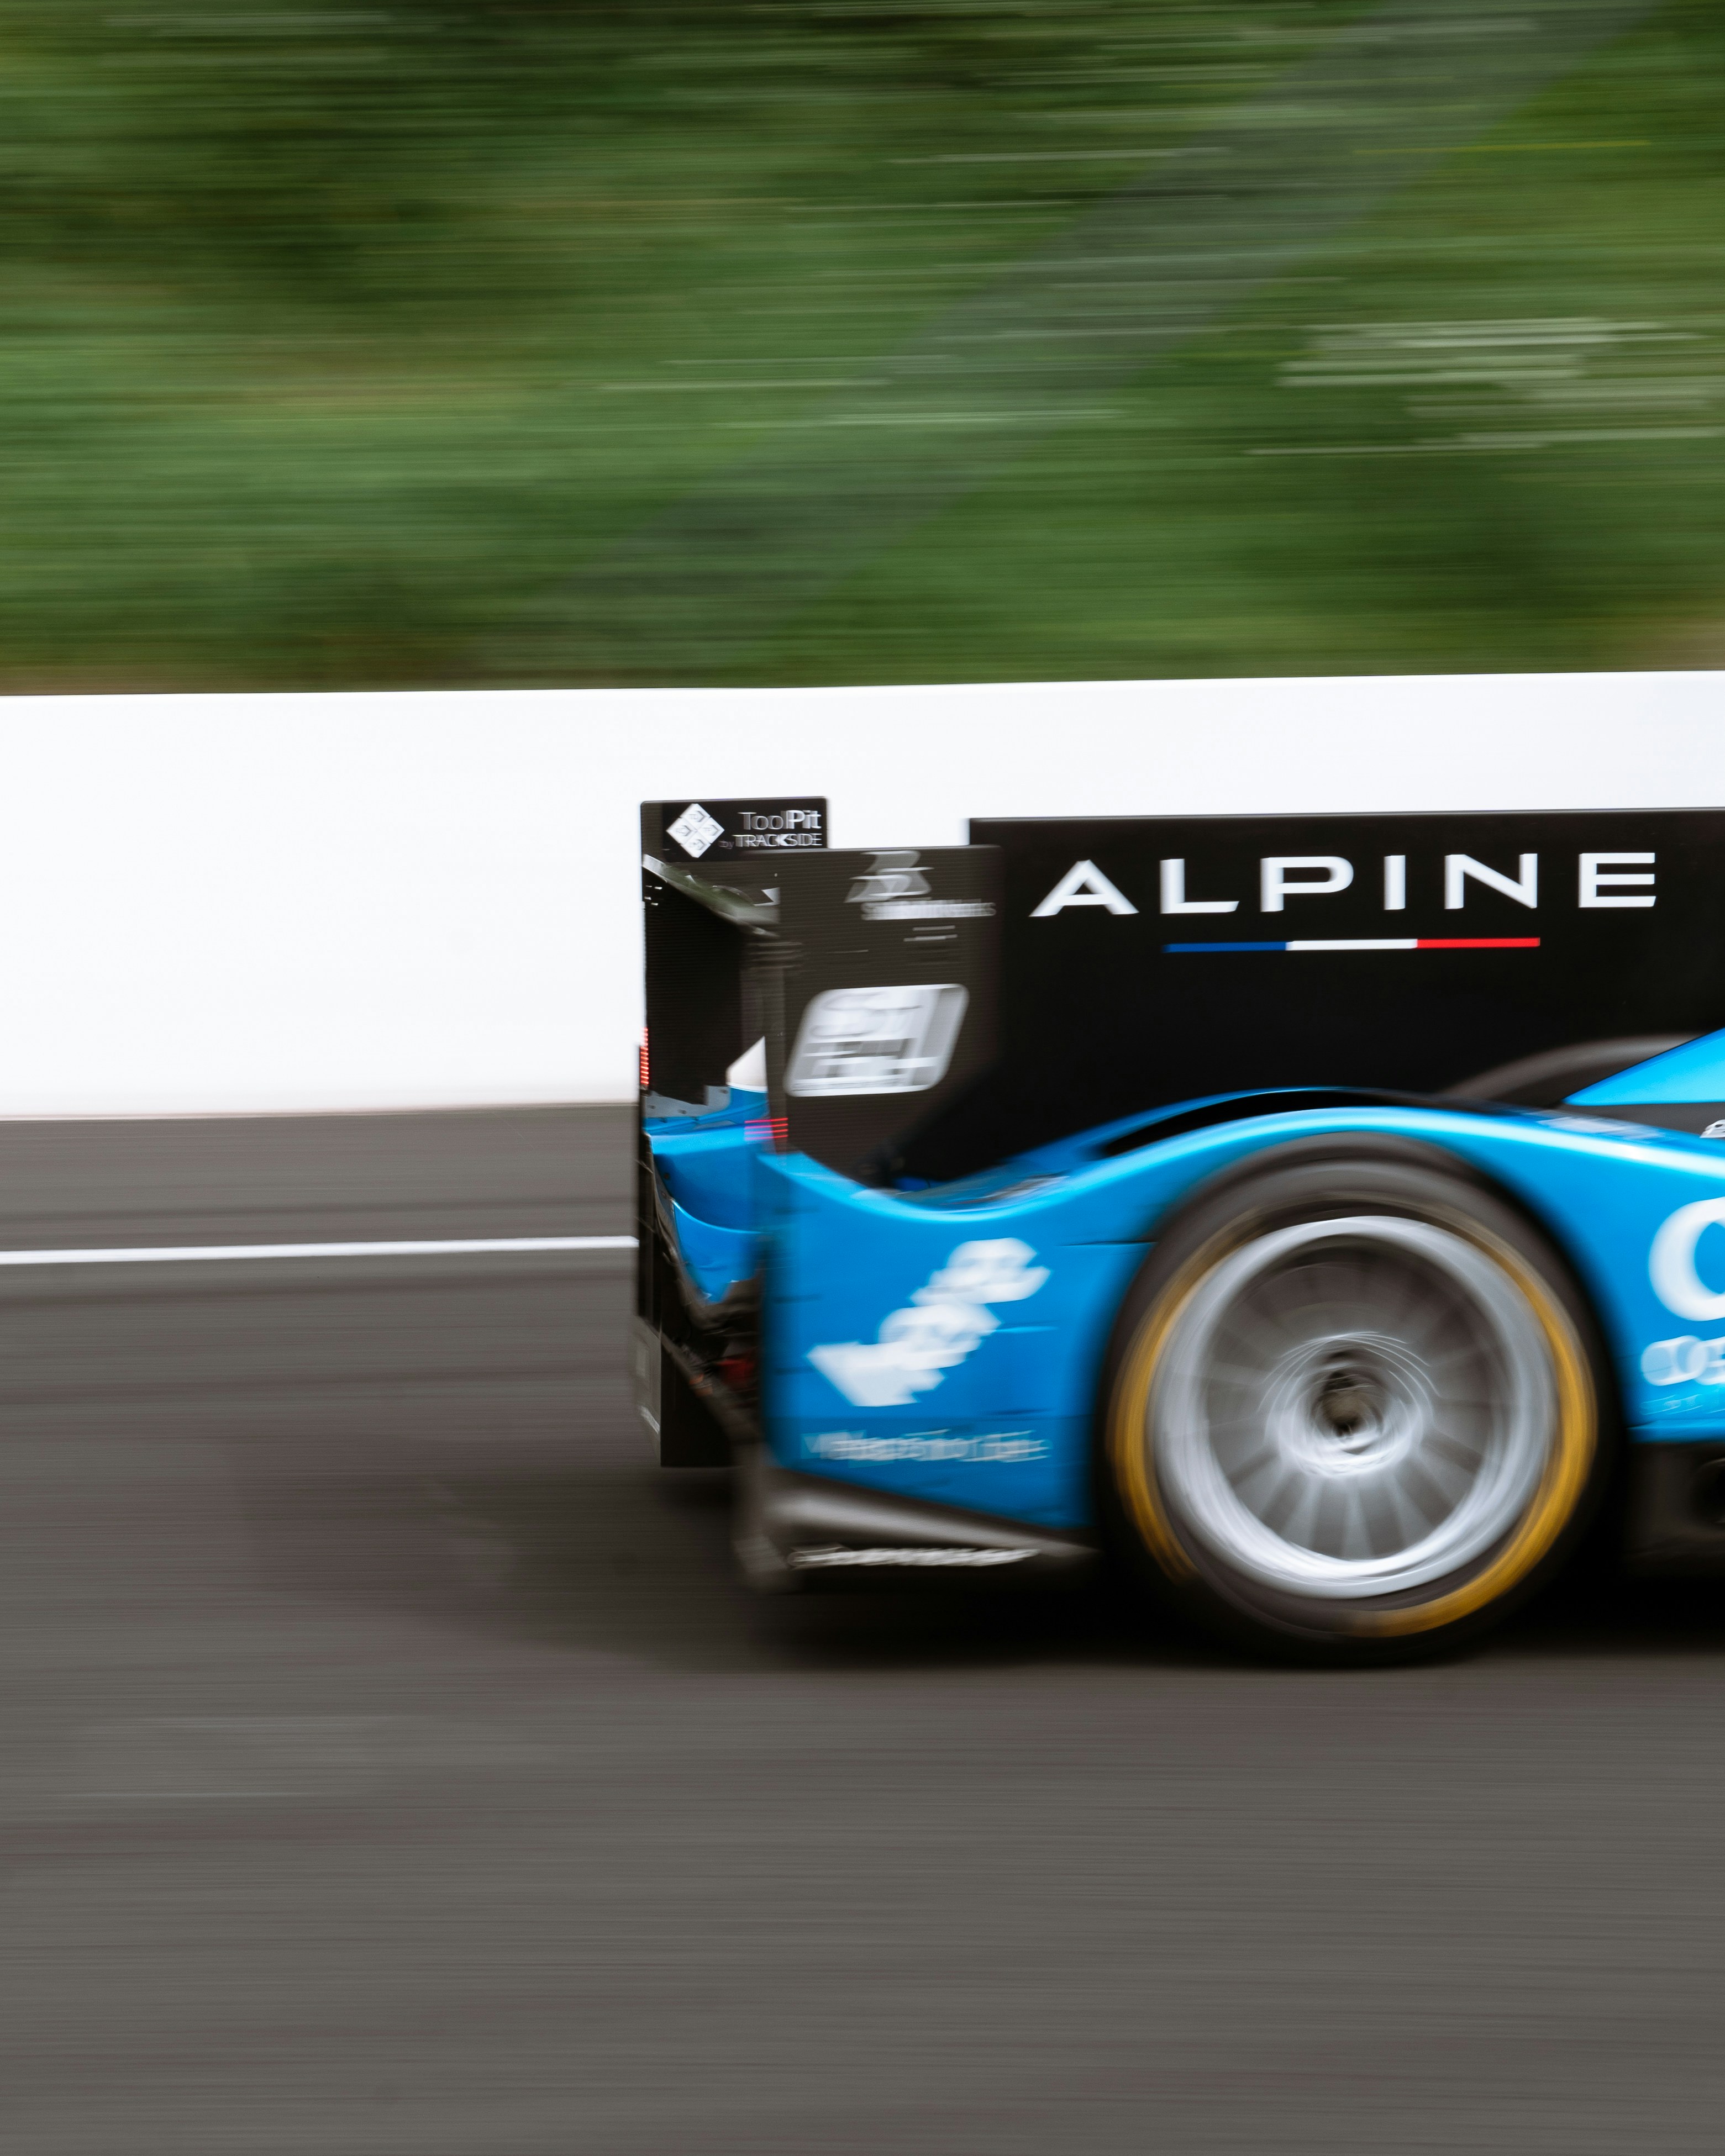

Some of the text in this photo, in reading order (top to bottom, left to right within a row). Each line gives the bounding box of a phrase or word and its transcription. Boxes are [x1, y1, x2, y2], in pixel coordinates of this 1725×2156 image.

[738, 810, 822, 830] ToolPit
[732, 833, 823, 847] TRACKSIDE
[1029, 852, 1656, 918] ALPINE
